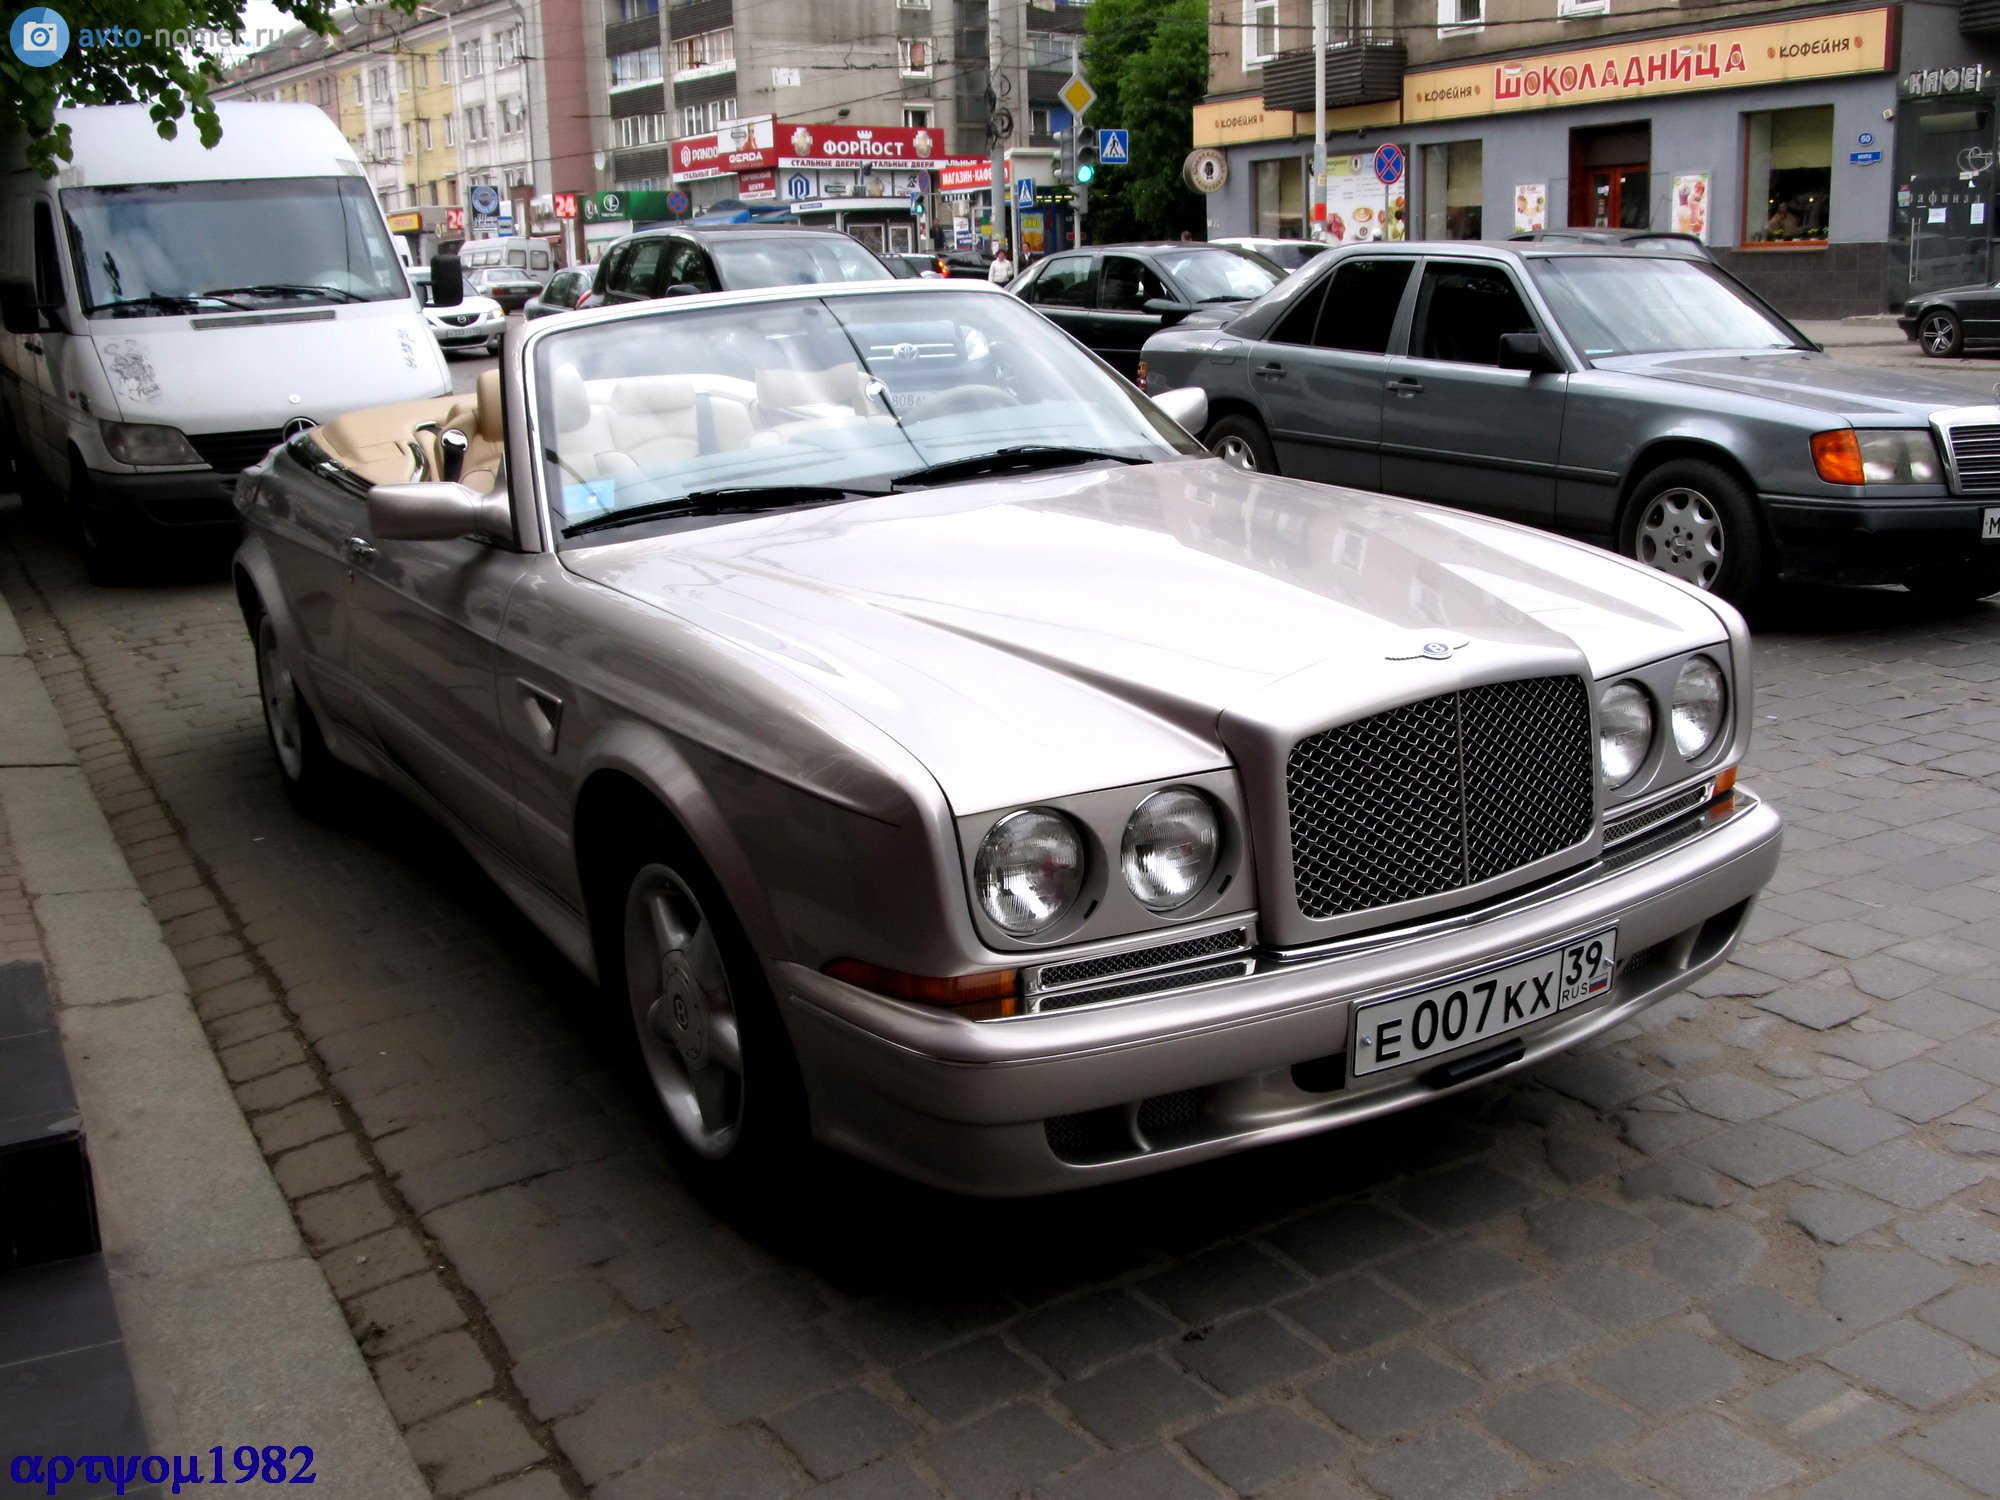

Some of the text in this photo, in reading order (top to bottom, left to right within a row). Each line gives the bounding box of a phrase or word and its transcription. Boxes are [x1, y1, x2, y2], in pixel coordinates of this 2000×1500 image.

[1778, 37, 1851, 59] КОФЕЙНЯ
[1494, 43, 1747, 100] ШОКОЛАДНИЦА
[1909, 66, 1981, 95] КАФЕ
[1424, 86, 1472, 102] КОФЕЙНЯ
[1220, 115, 1258, 128] КОФЕЙНЯ
[728, 151, 763, 163] GERDA
[823, 139, 904, 156] ФОРПОСТ
[791, 159, 832, 167] СТАЛЬНЫЕ
[911, 161, 935, 169] ДВЕРИ
[554, 193, 576, 217] 24
[1565, 940, 1603, 986] 39
[1562, 982, 1588, 1003] RUS
